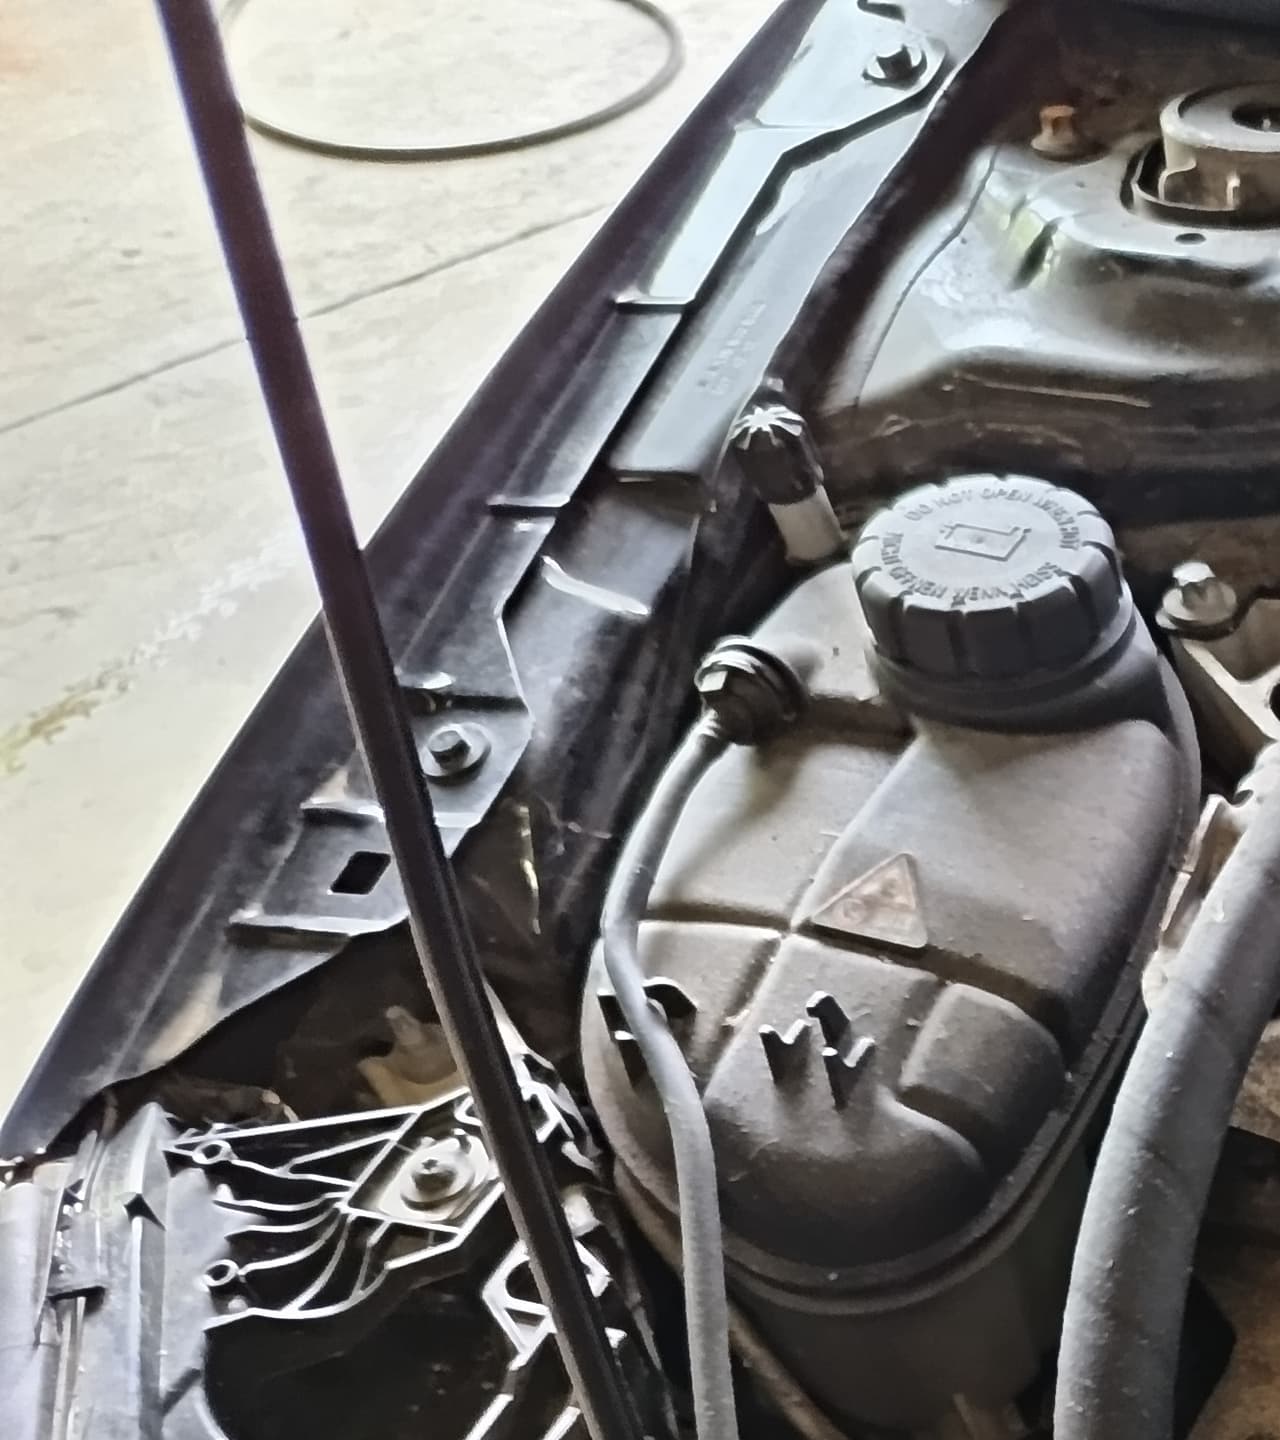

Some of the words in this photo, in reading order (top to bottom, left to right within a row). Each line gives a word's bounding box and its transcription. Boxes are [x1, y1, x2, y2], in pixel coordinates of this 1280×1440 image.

[904, 503, 932, 521] DO
[934, 489, 973, 507] NOT
[980, 488, 1033, 503] OPEN
